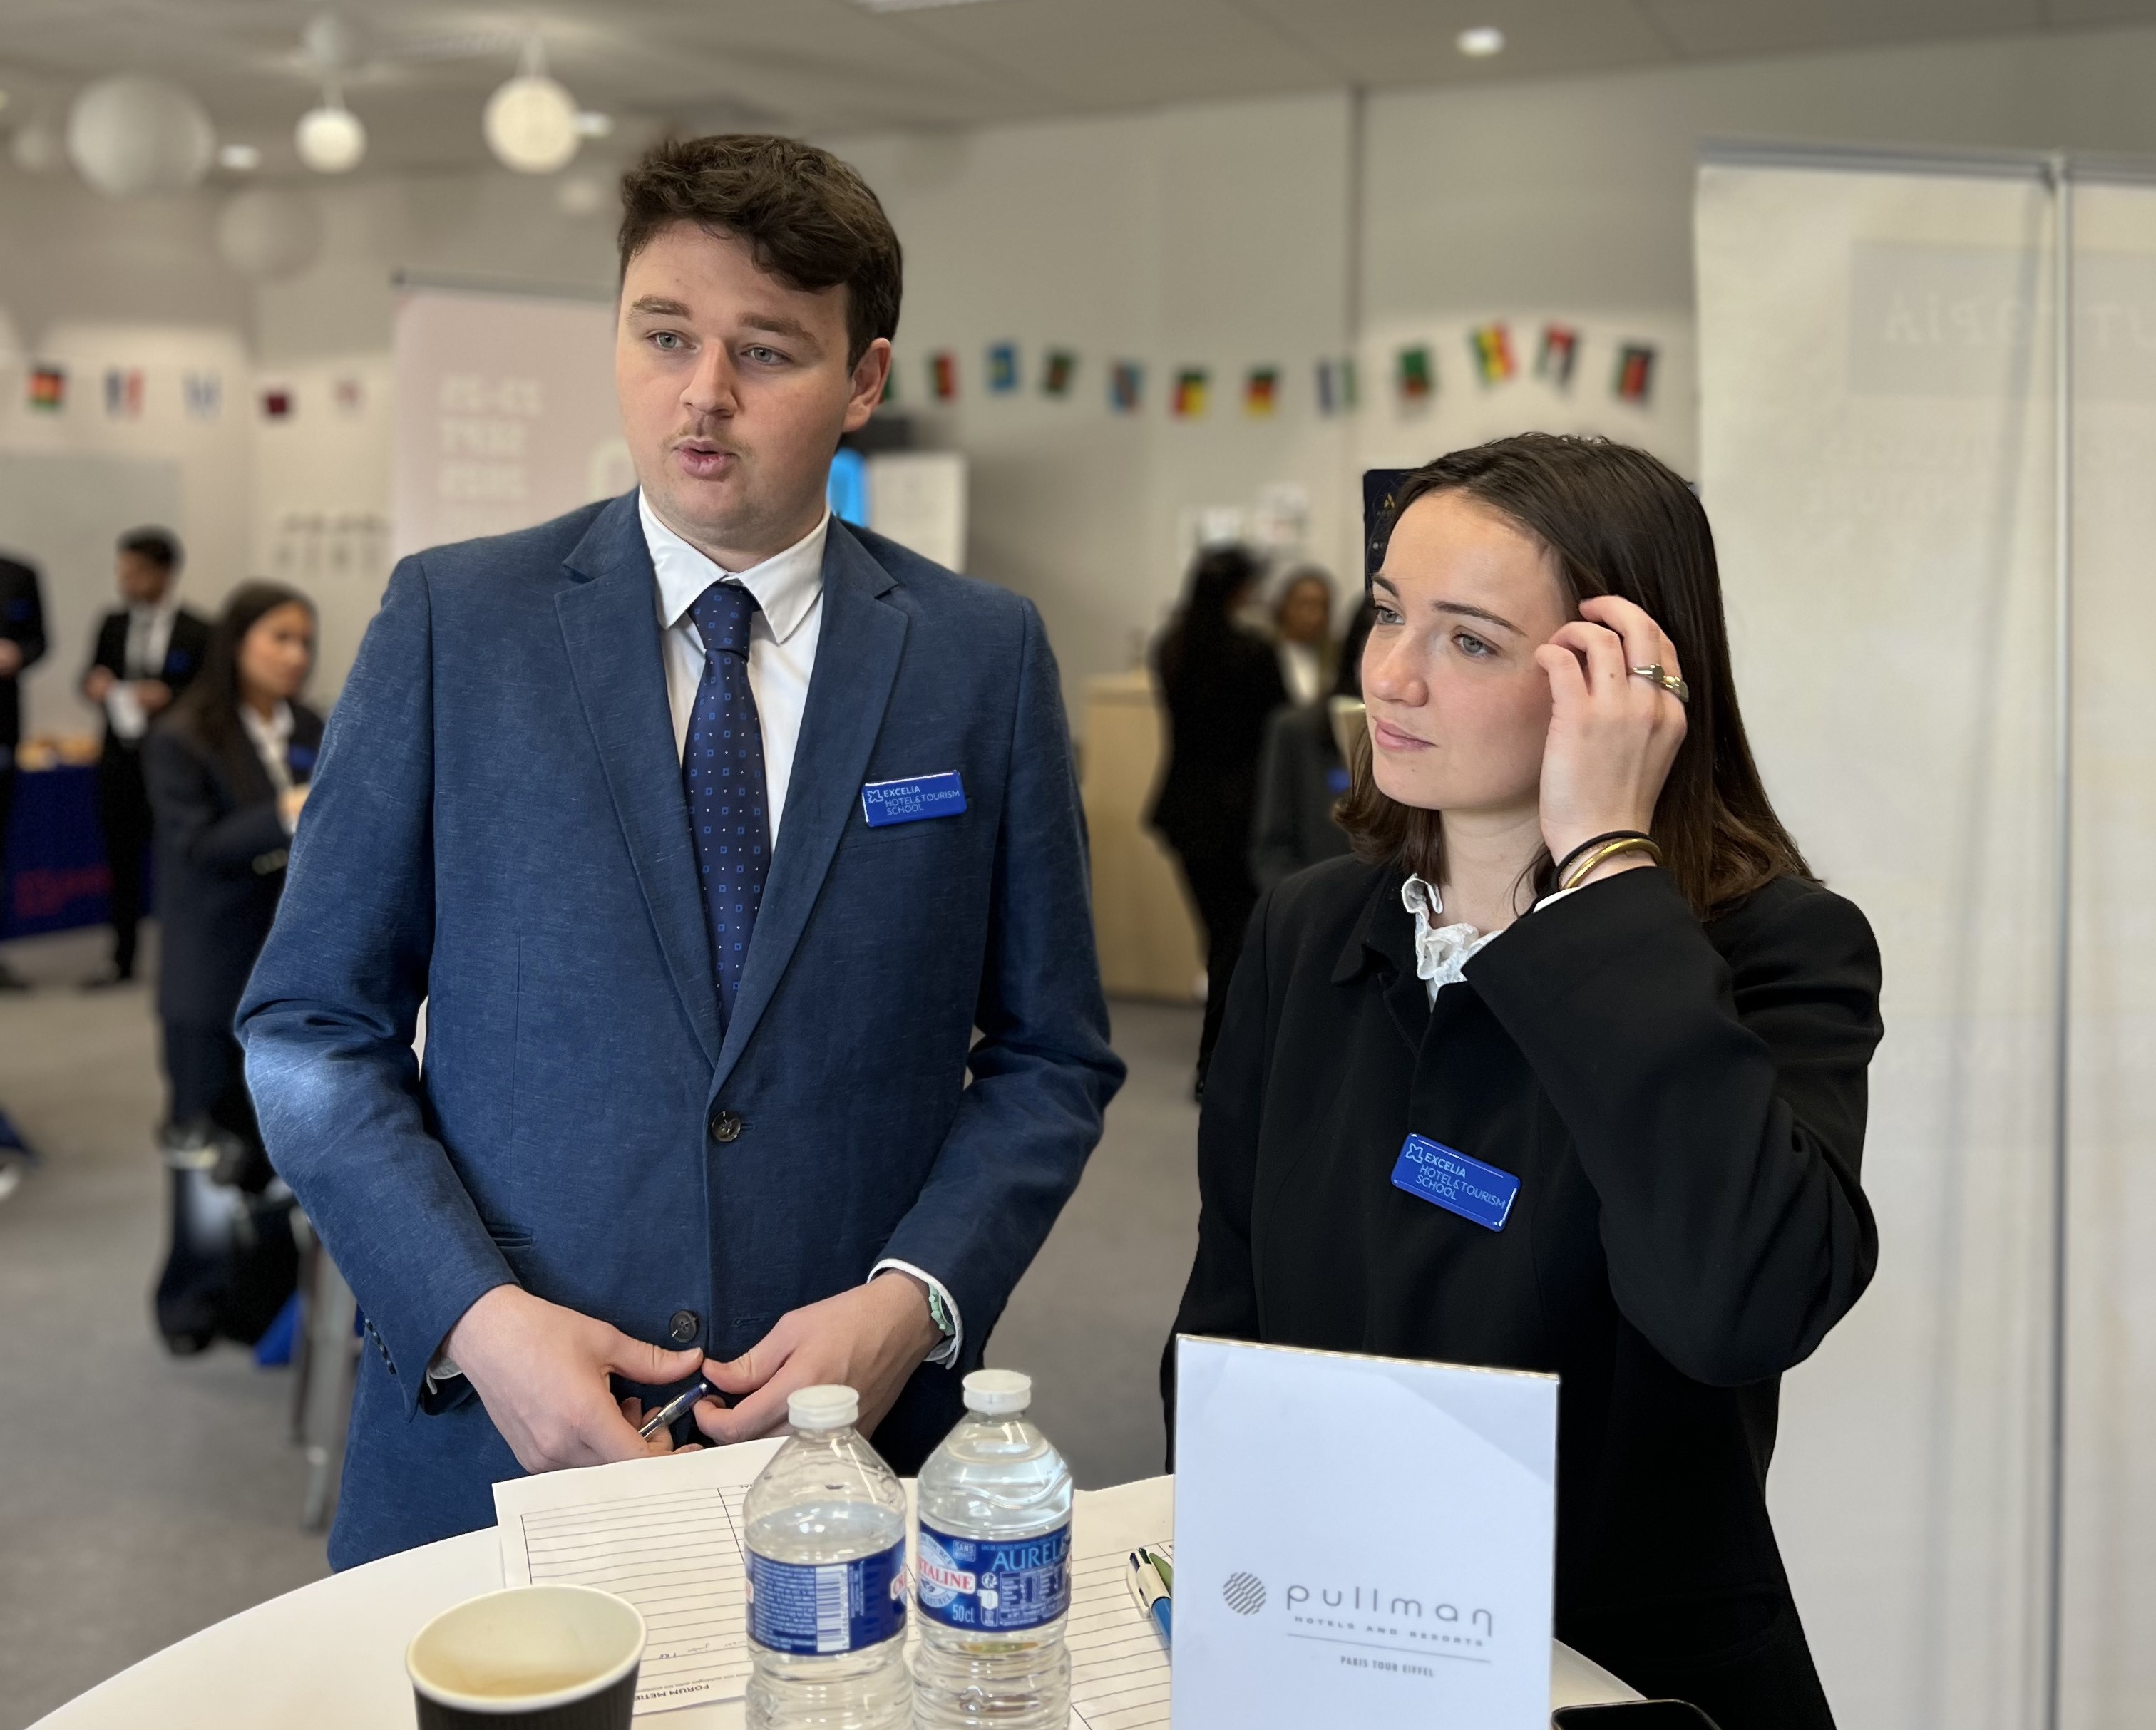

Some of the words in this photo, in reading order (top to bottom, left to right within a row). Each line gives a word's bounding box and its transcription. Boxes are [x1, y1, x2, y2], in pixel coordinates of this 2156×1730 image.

[883, 786, 921, 798] EXCELIA
[886, 803, 924, 815] SCHOOL
[1425, 1153, 1466, 1178] EXCELIA
[1416, 1174, 1457, 1200] SCHOOL
[953, 1604, 975, 1623] 50cl
[1287, 1585, 1492, 1637] pullman
[1295, 1616, 1355, 1629] HOTELS
[1366, 1626, 1397, 1635] AND
[1410, 1631, 1483, 1647] RESORTS
[1340, 1656, 1368, 1668] PARIS
[1372, 1659, 1398, 1672] TOUR
[1402, 1664, 1434, 1677] EIFFEL
[669, 1684, 709, 1696] FORUM
